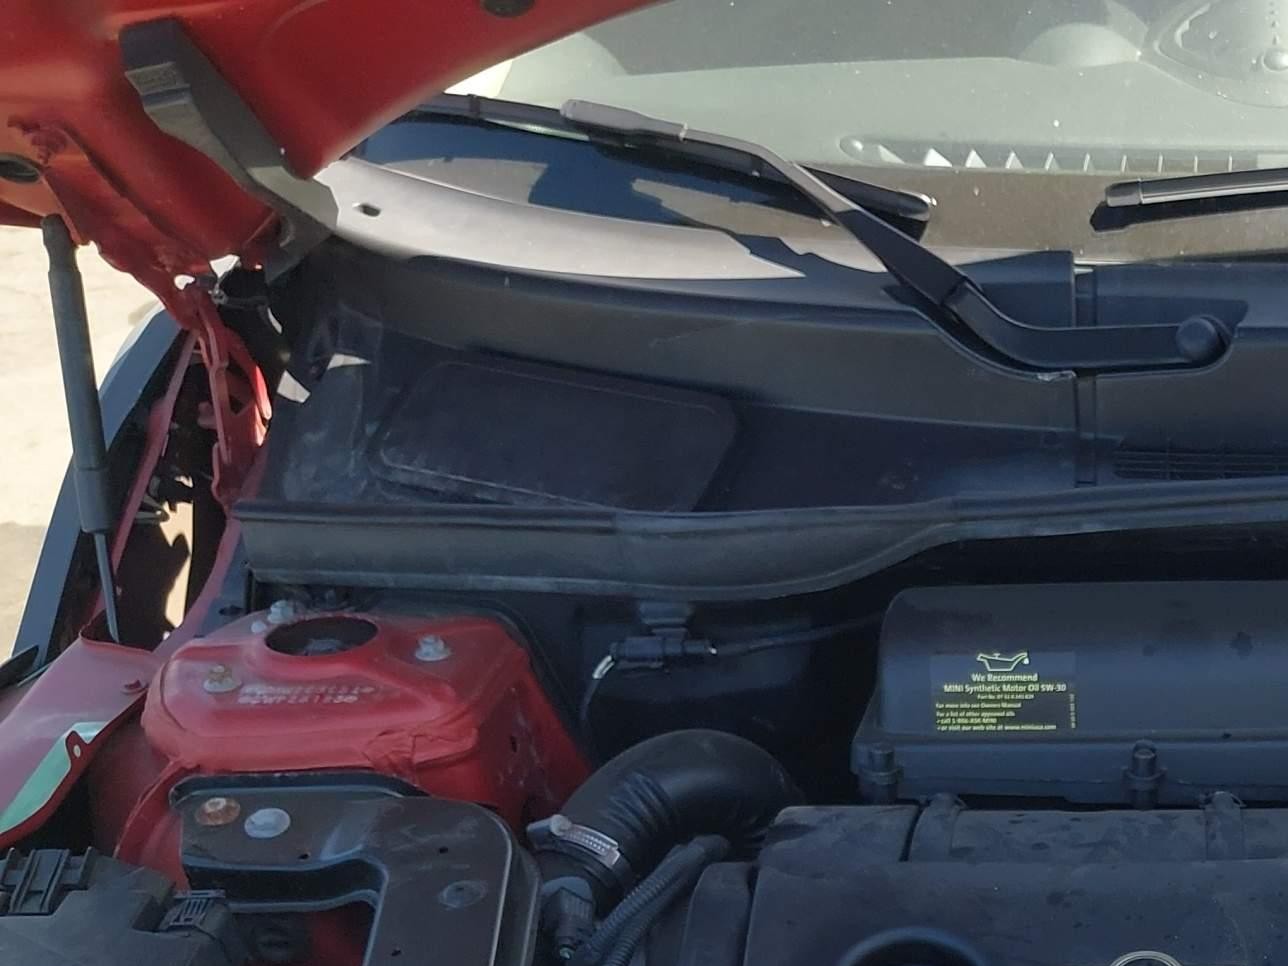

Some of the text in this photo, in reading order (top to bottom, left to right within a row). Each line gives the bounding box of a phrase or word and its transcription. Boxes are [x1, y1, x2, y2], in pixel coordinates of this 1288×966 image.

[971, 673, 1038, 682] We Recommend
[944, 684, 963, 693] MINI
[965, 683, 1000, 695] Synthetic
[1003, 684, 1026, 693] Motor
[1041, 684, 1067, 693] 5W-30
